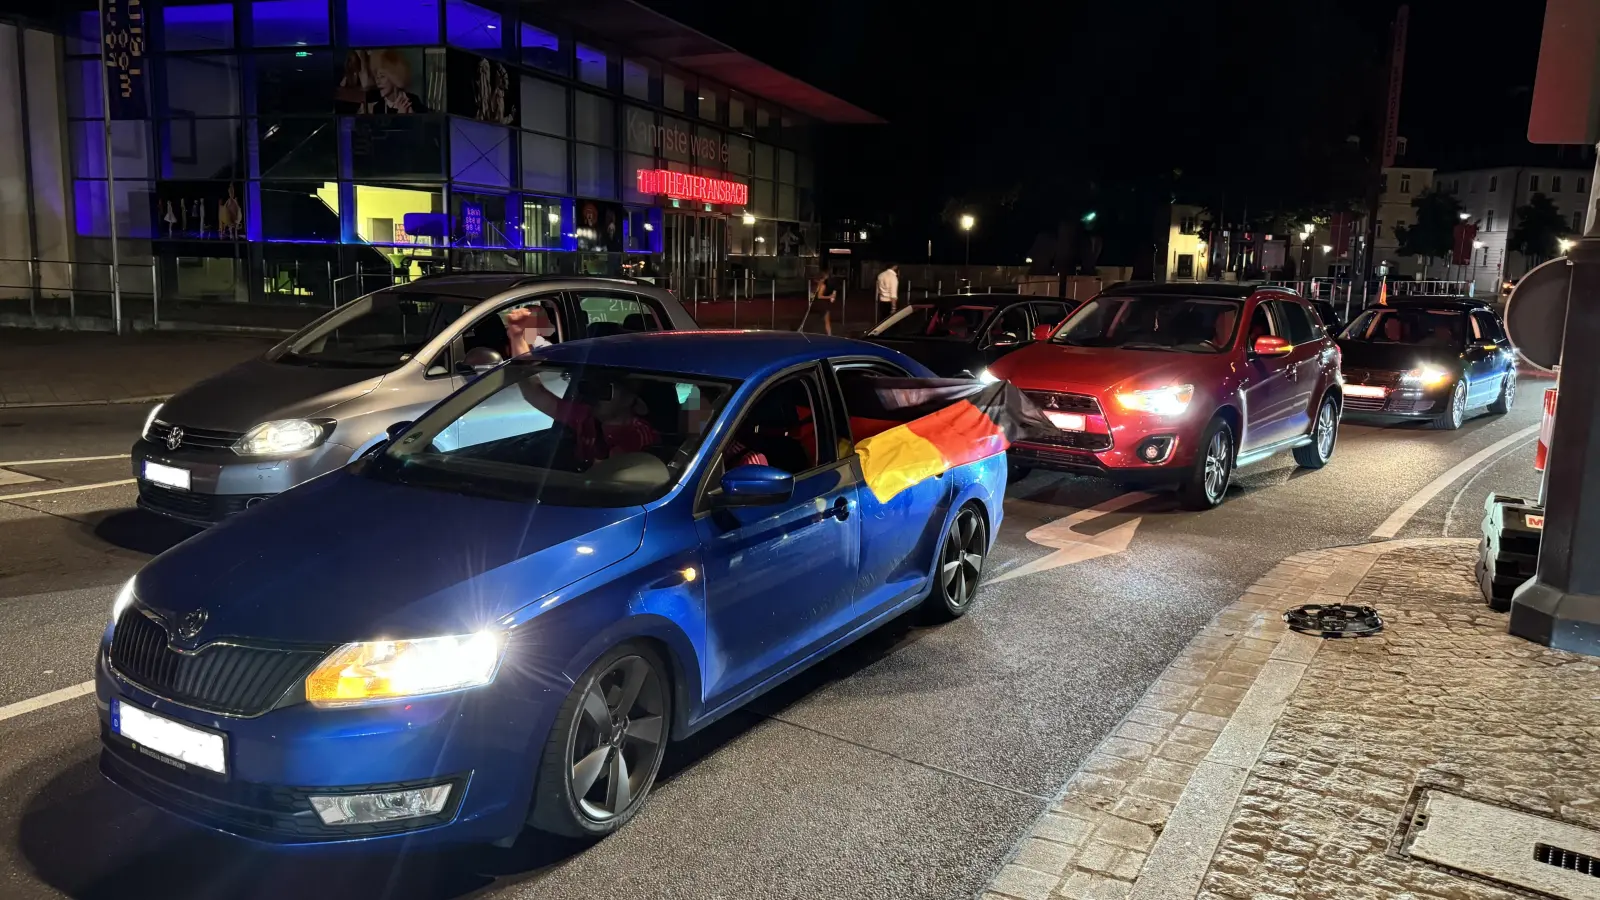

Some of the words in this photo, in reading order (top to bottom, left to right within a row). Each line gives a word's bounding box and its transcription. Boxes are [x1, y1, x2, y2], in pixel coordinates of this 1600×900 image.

[627, 109, 687, 153] Kannste
[690, 133, 716, 160] was
[661, 168, 707, 200] THEATER
[706, 177, 749, 205] ANSBACH
